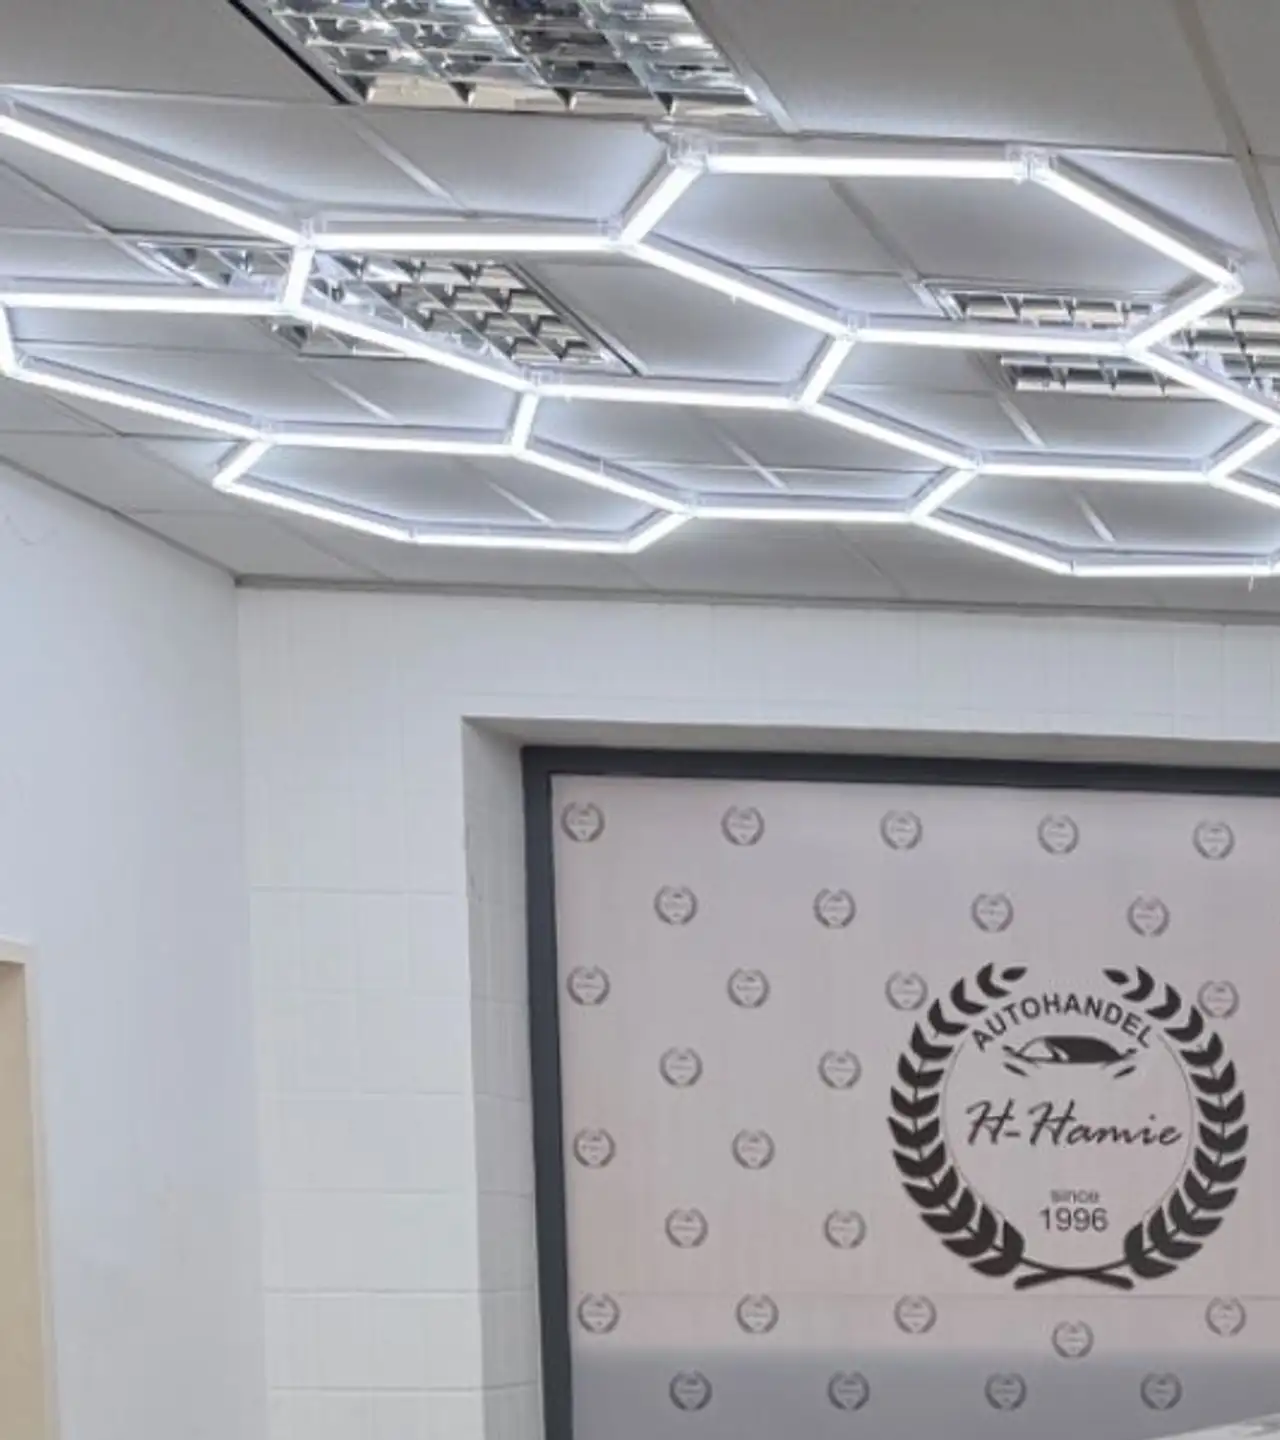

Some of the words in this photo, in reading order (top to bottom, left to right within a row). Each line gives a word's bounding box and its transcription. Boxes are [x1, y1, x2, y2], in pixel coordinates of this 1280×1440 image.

[971, 994, 1152, 1051] AUTOHANDEL
[965, 1098, 1183, 1146] H-Hamie
[1039, 1206, 1109, 1233] 1996
